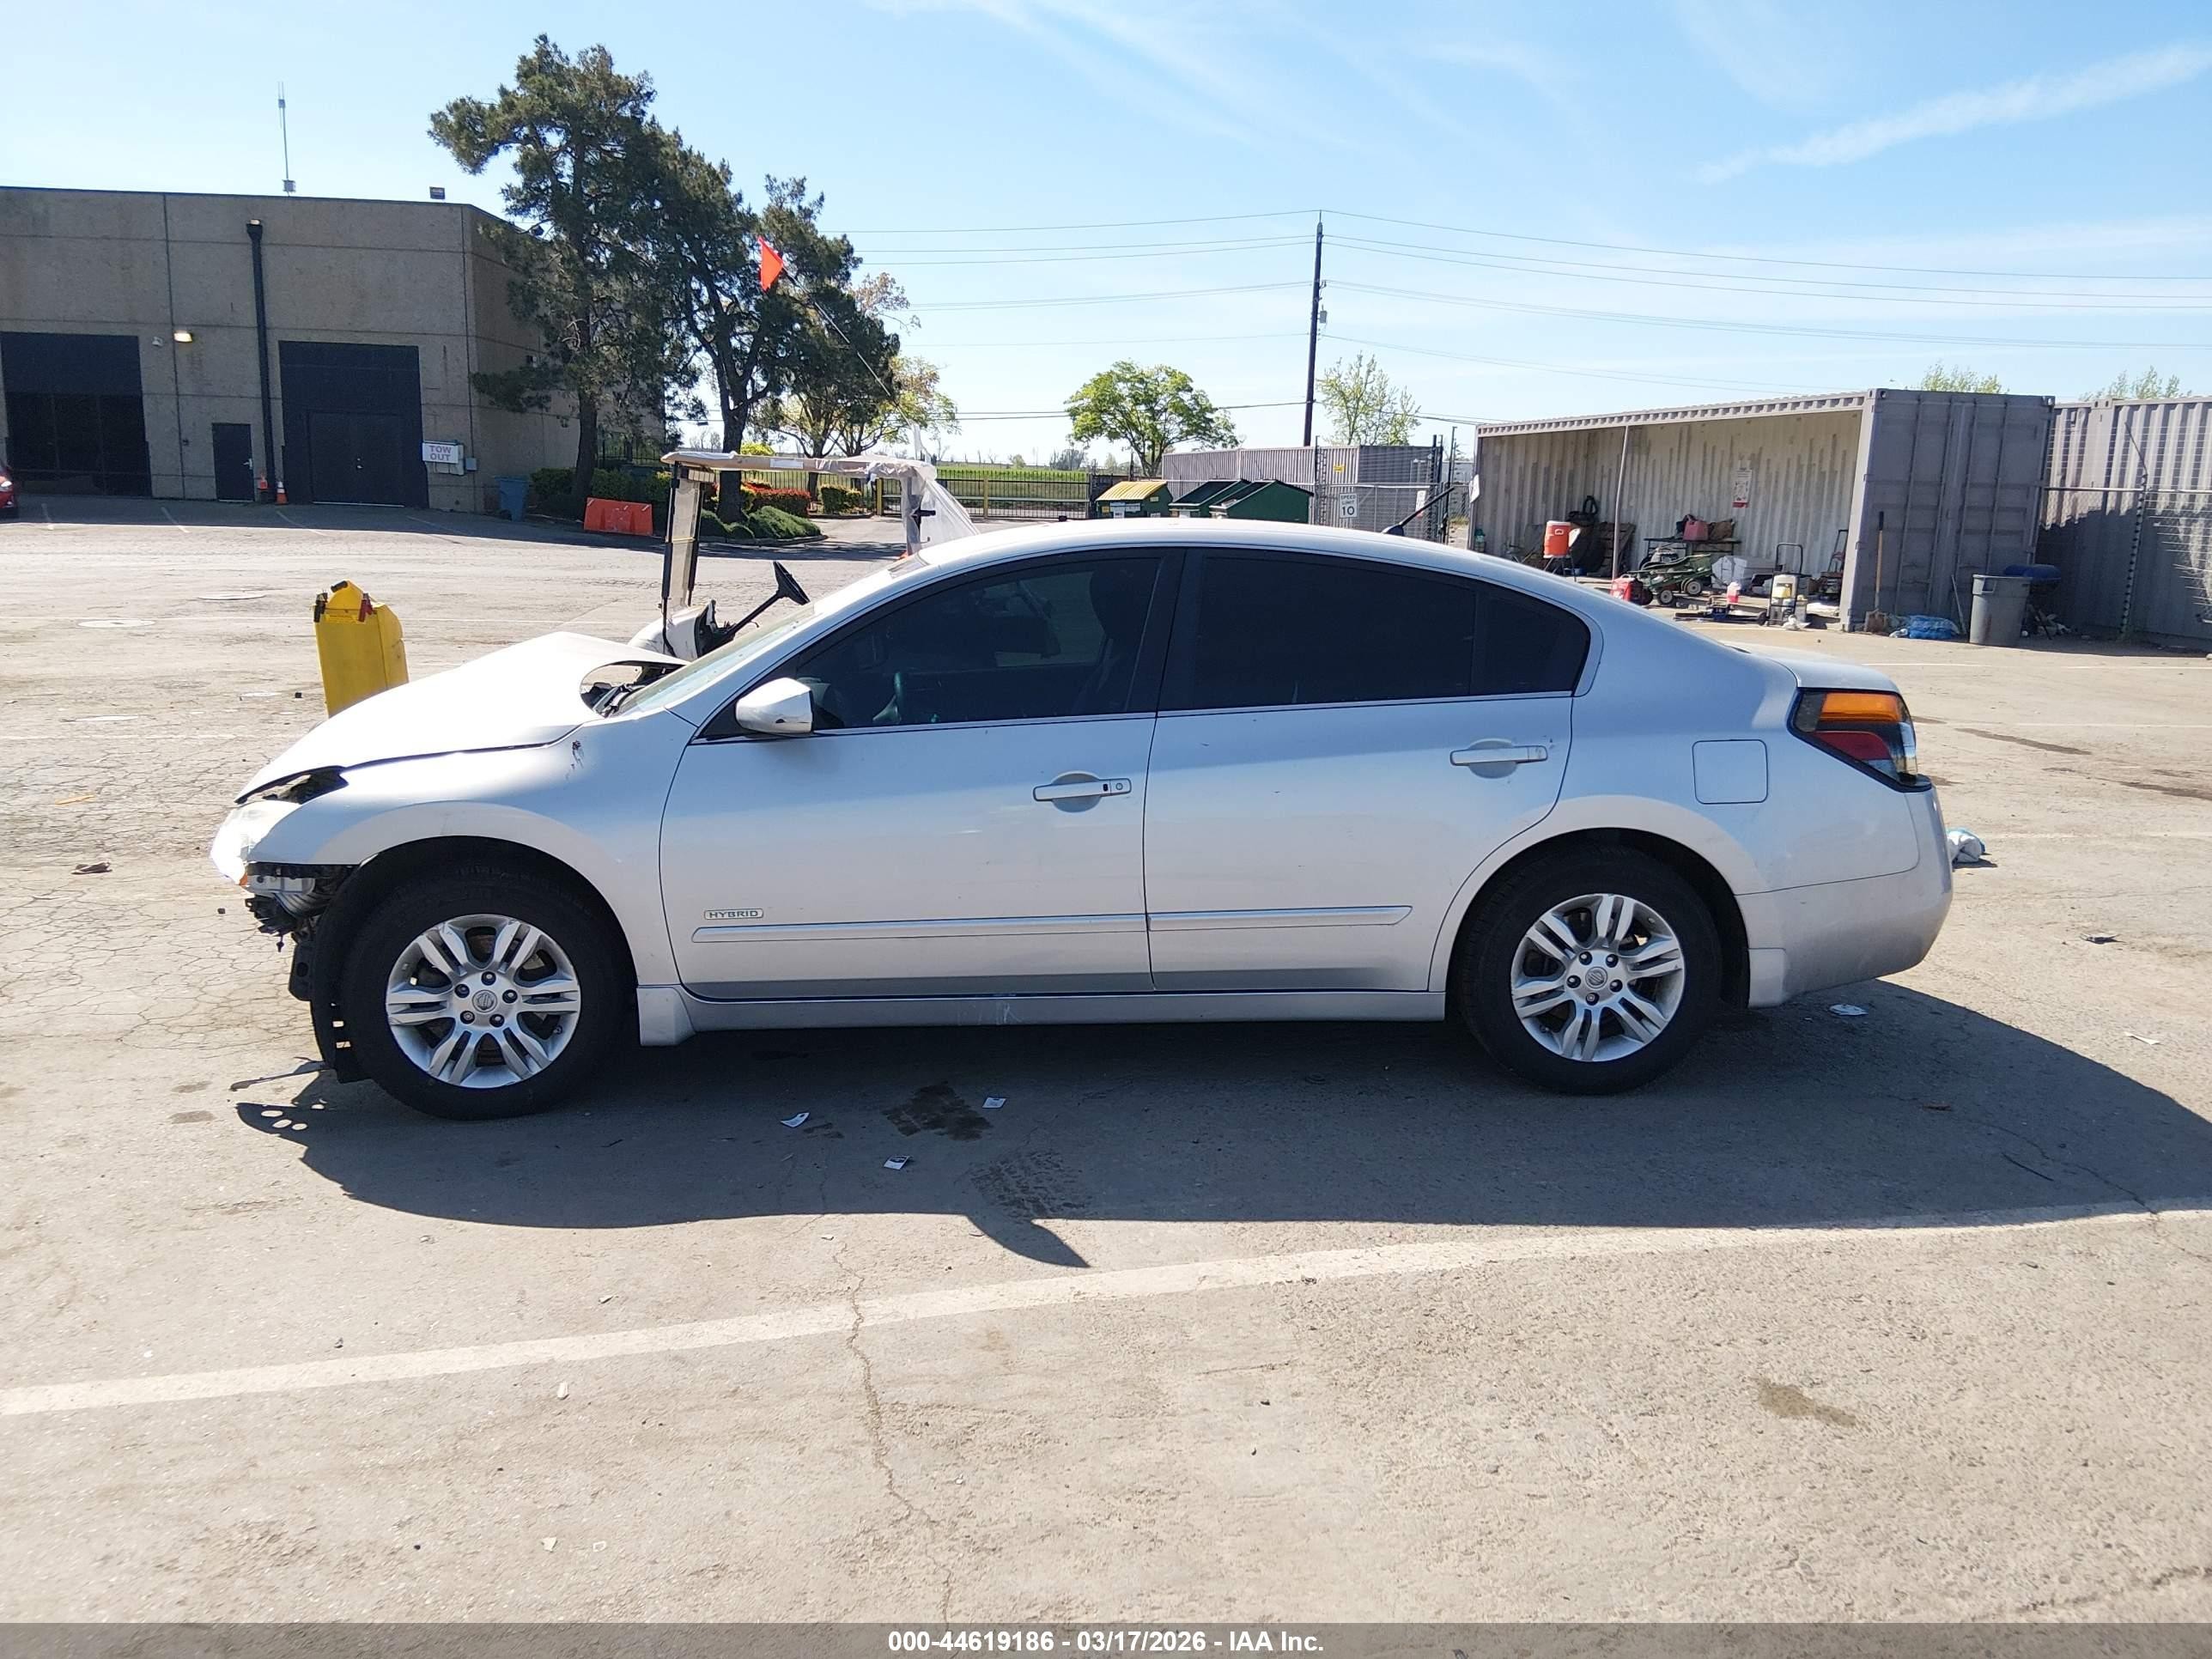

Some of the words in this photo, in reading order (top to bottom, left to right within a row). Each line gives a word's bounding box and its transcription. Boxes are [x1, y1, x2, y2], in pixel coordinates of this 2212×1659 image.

[428, 445, 452, 453] TOW
[429, 453, 451, 461] OUT
[1341, 506, 1355, 516] 10
